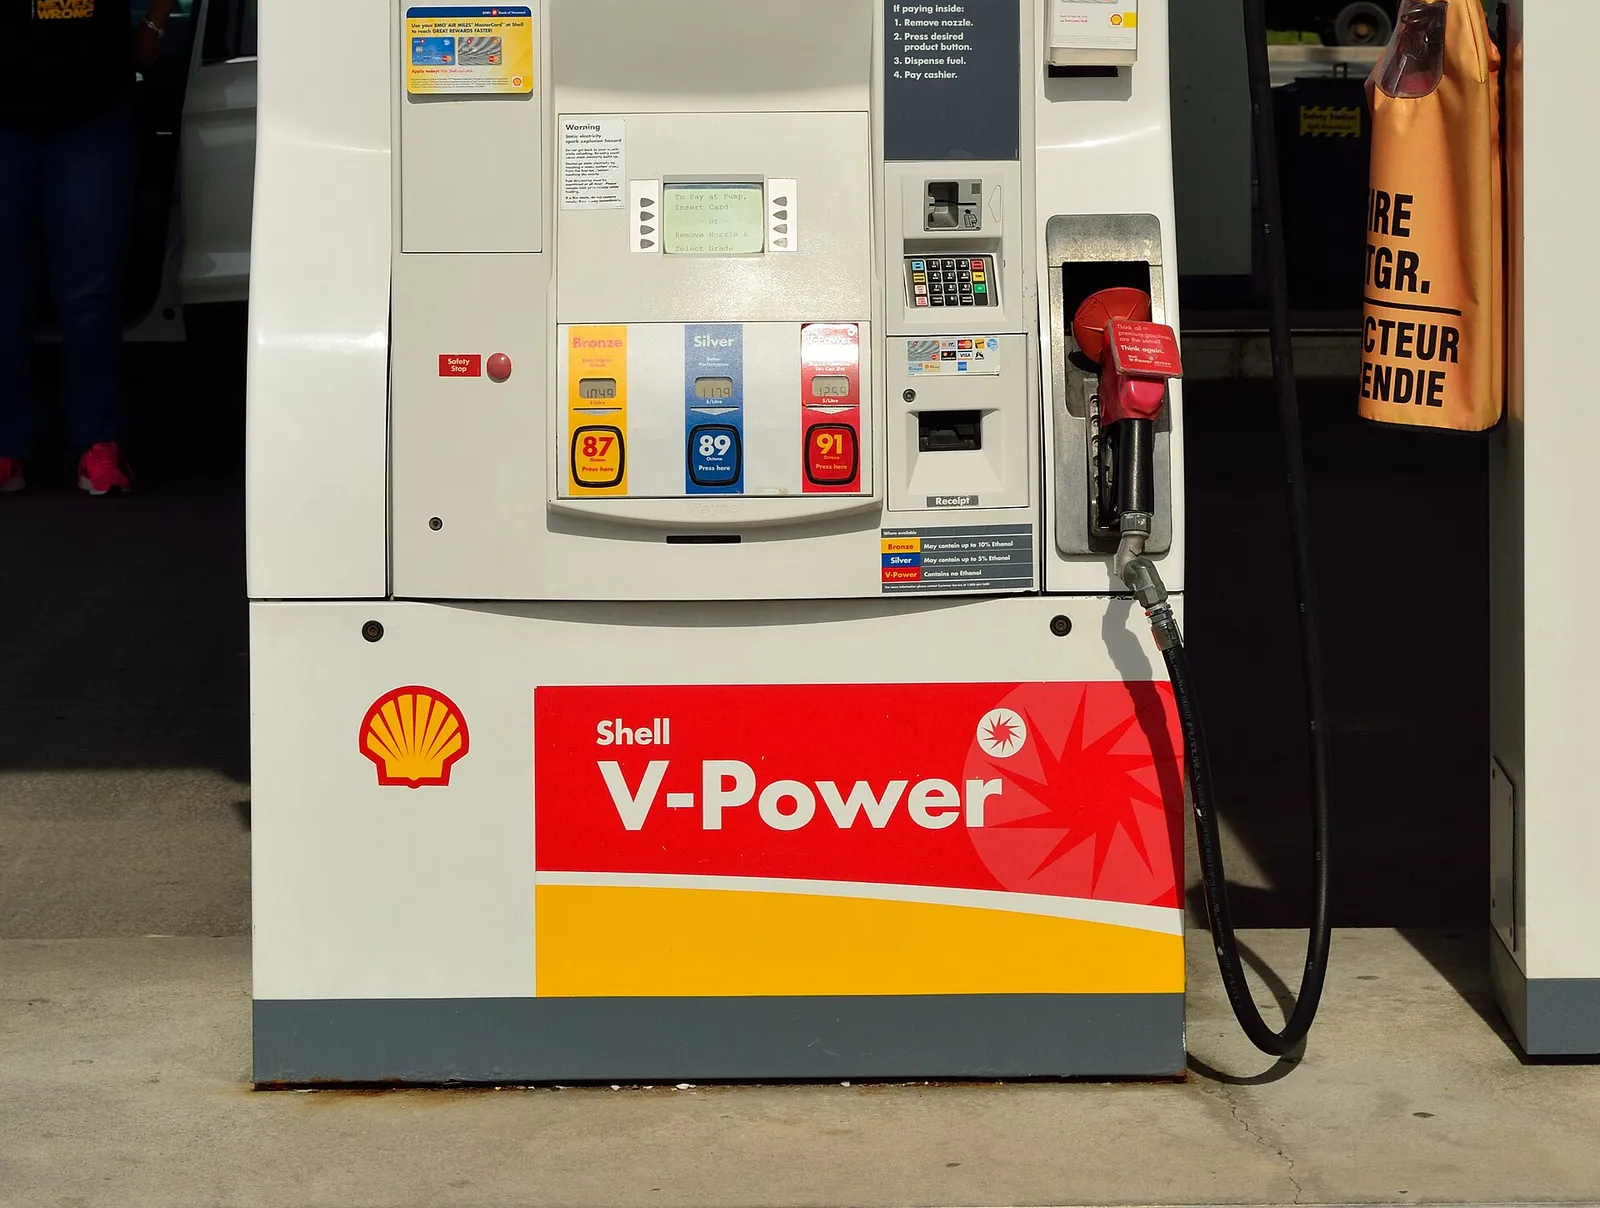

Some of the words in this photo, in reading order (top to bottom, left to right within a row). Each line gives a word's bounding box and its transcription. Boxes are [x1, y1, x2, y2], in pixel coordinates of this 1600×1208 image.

[37, 8, 95, 20] WRONG
[902, 5, 933, 14] paying
[931, 32, 964, 40] desired
[904, 43, 938, 52] product
[904, 57, 944, 66] Dispense
[904, 71, 921, 80] Pay
[572, 337, 623, 348] Bronze
[693, 335, 735, 347] Silver
[1362, 315, 1460, 364] CTEUR
[447, 358, 470, 366] Safety
[451, 365, 467, 373] Stop
[1360, 361, 1446, 408] ENDIE
[582, 436, 615, 457] 87
[699, 435, 731, 456] 89
[816, 433, 843, 455] 91
[935, 496, 970, 506] Receipt
[596, 718, 670, 746] Shell
[597, 760, 1003, 832] V-Power
